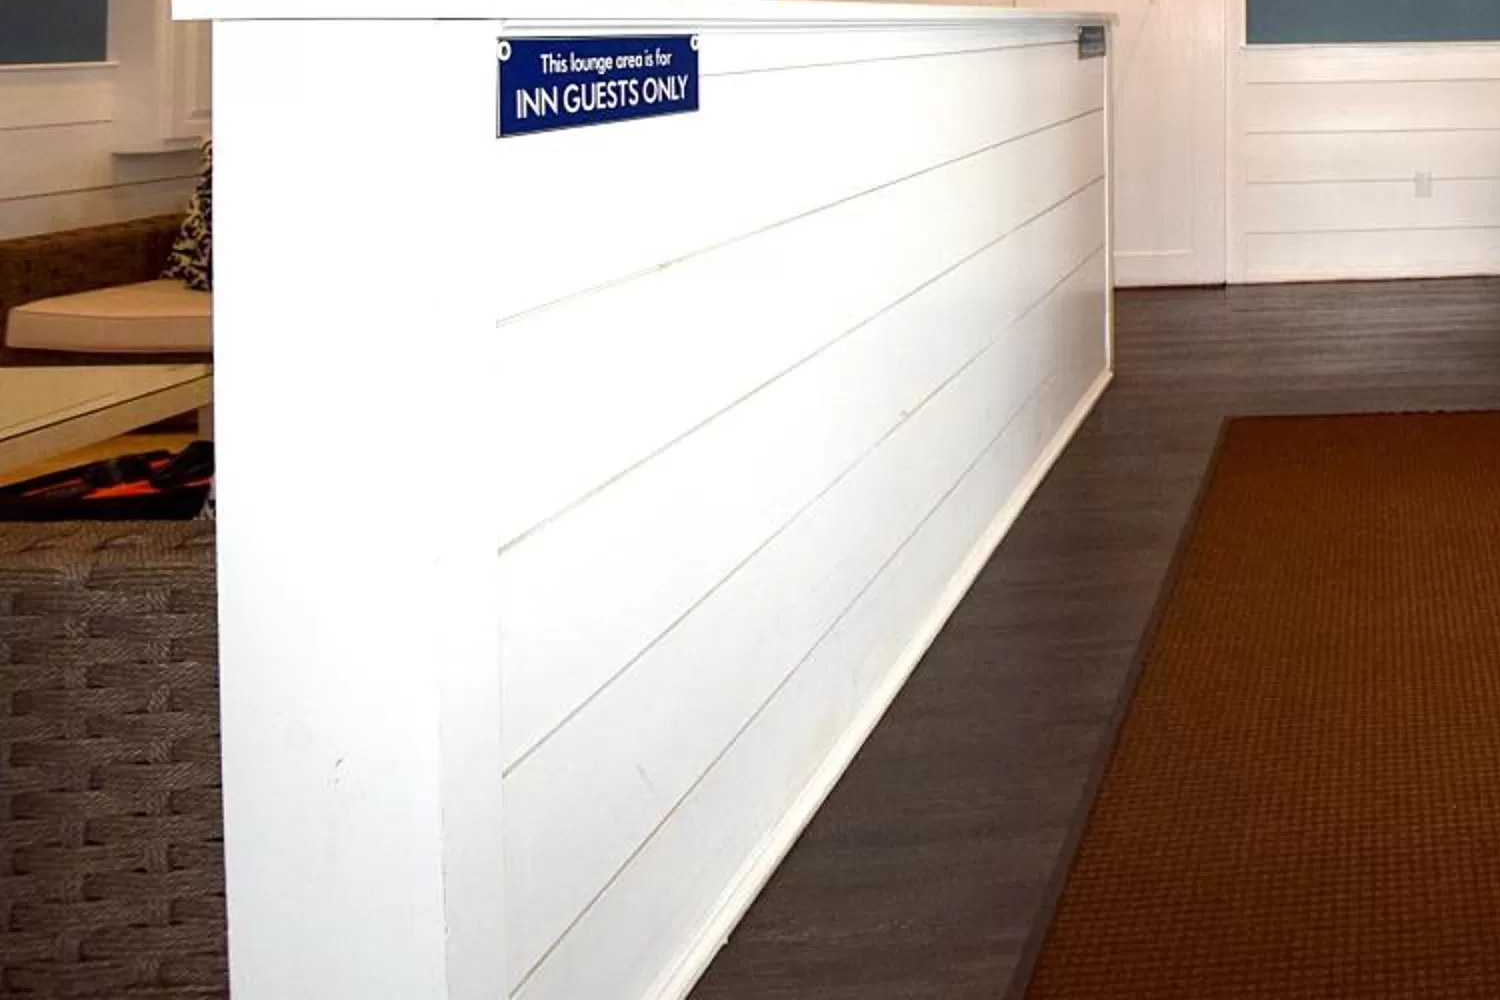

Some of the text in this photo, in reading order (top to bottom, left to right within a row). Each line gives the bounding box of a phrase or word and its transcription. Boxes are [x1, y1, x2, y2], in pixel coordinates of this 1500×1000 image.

[540, 48, 673, 75] This lounge area is for
[516, 74, 689, 119] INN GUESTS ONLY
